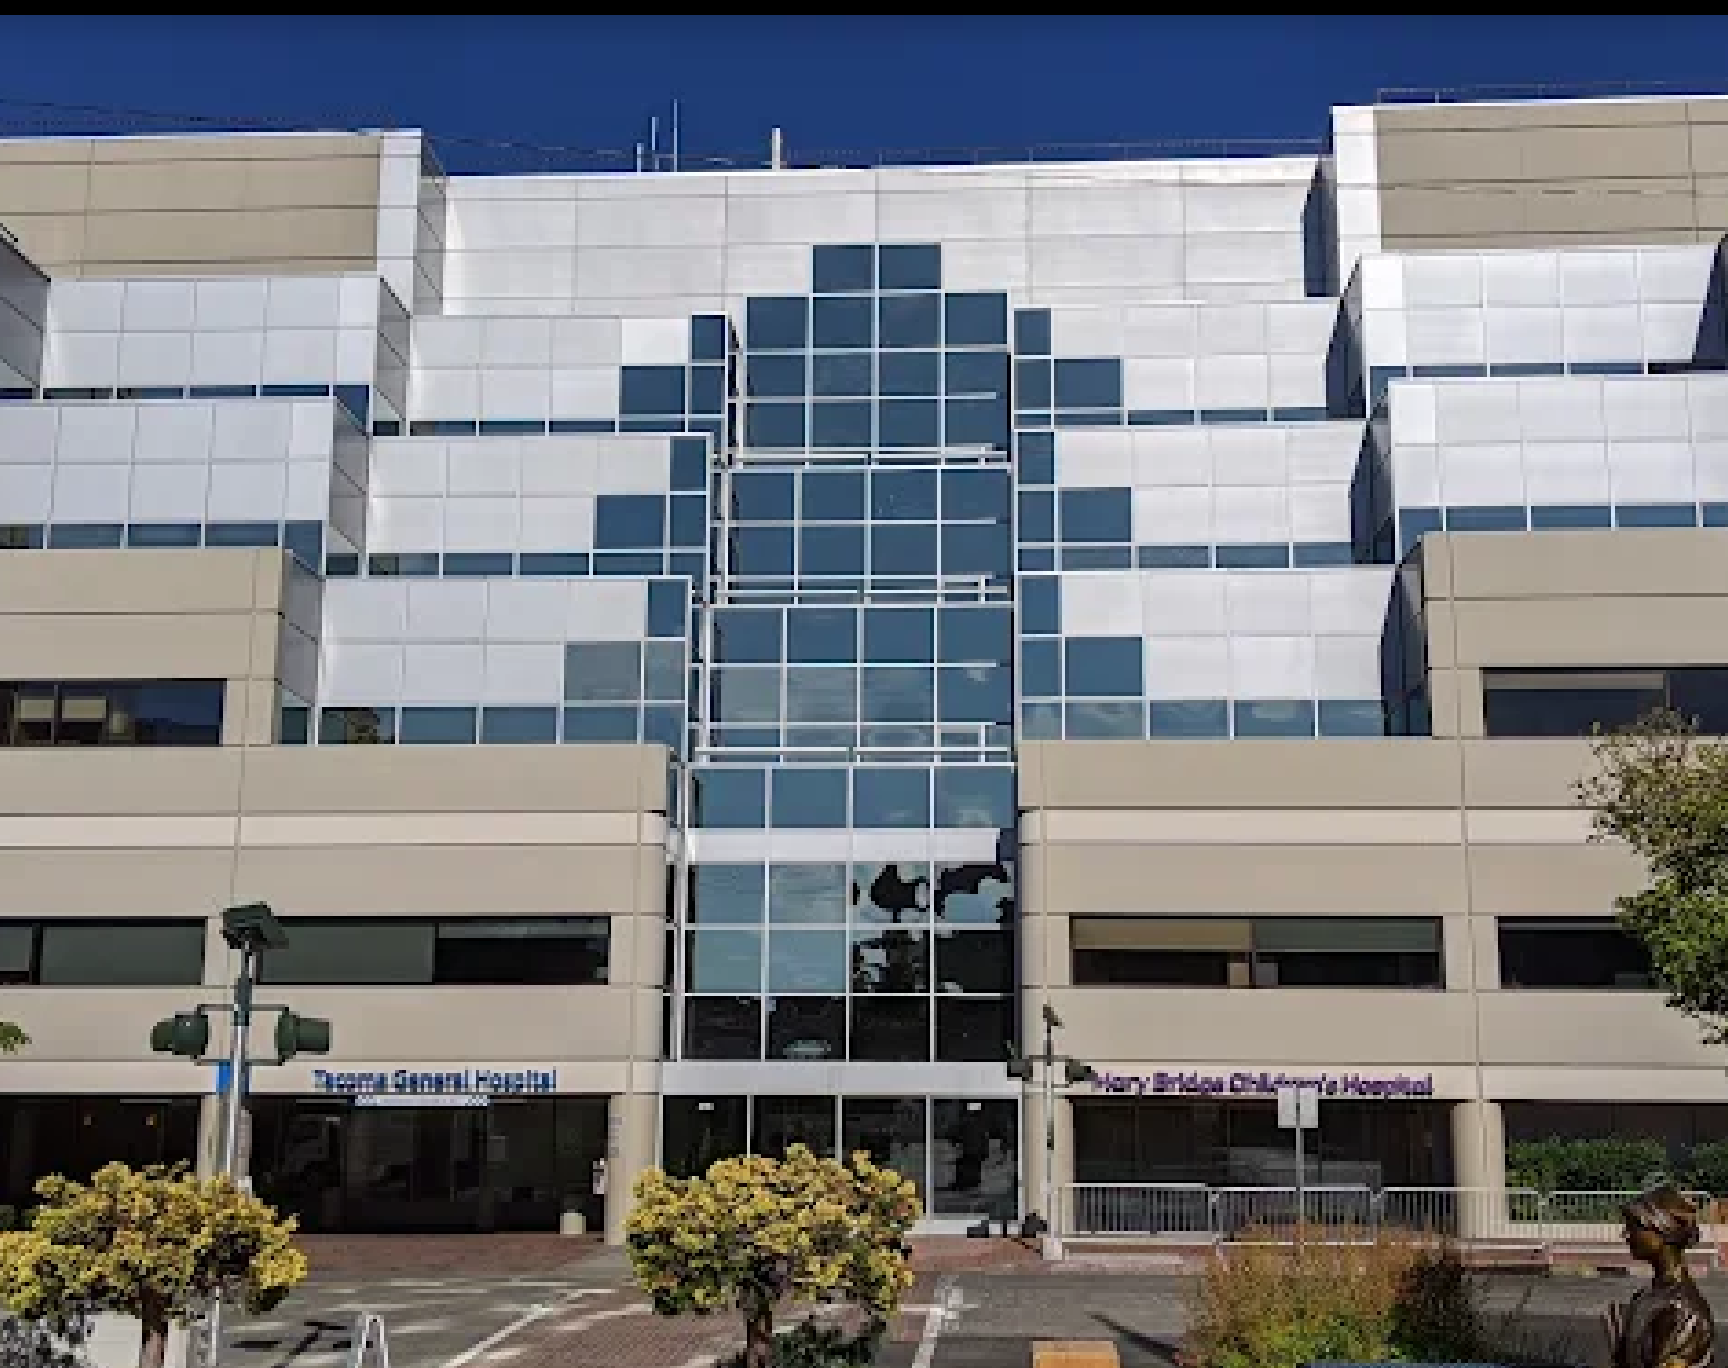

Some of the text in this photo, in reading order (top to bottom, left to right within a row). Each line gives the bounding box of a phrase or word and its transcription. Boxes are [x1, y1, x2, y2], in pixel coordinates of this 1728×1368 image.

[314, 1067, 557, 1094] Tacoma General Hospital
[1153, 1071, 1224, 1098] Bridge
[1343, 1072, 1433, 1100] Hospital
